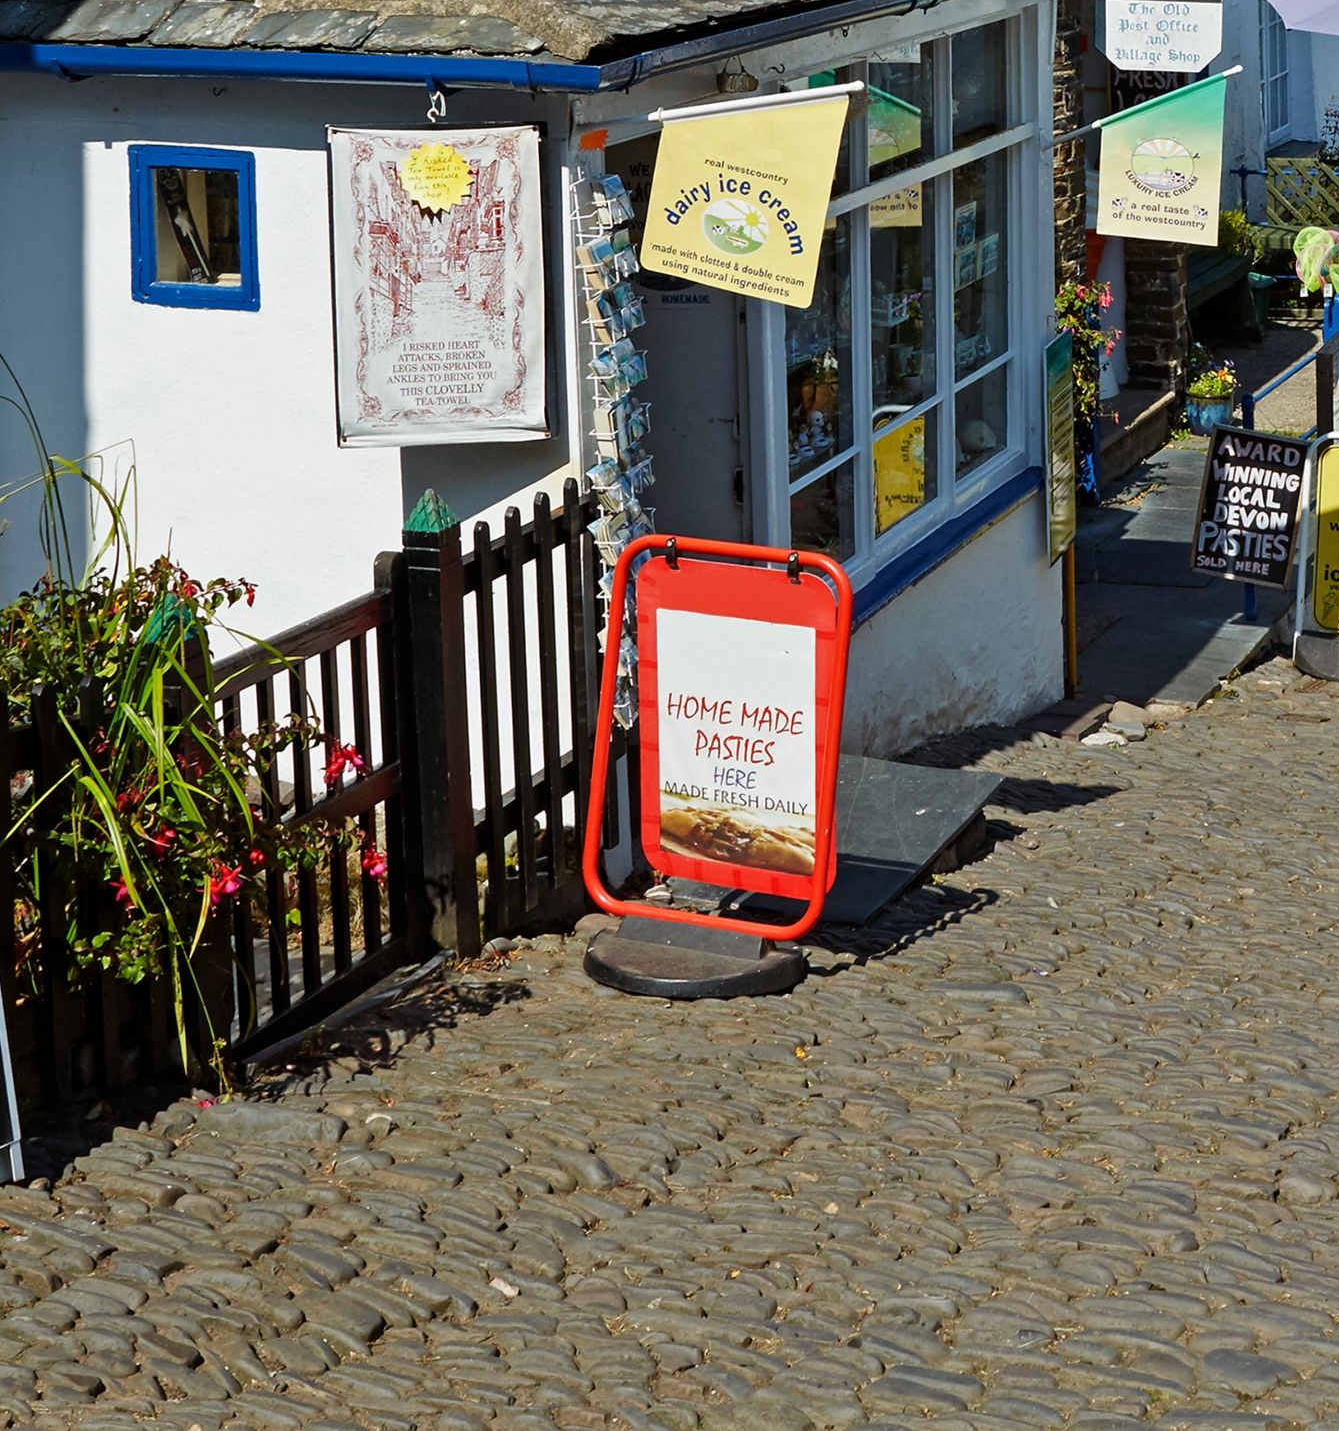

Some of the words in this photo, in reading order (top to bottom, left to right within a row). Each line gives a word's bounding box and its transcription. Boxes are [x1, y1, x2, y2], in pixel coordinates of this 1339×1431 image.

[1128, 3, 1155, 15] The
[1164, 3, 1190, 16] Old
[1118, 19, 1148, 33] Post
[1156, 19, 1199, 32] Office
[1146, 33, 1170, 46] and
[1115, 48, 1162, 65] Village
[1168, 49, 1200, 64] Shop
[704, 158, 725, 169] real
[727, 163, 789, 185] westcountry
[1125, 169, 1152, 196] LUXURY
[1155, 189, 1171, 199] ICE
[1174, 176, 1199, 197] CREAM
[664, 181, 711, 226] dairy
[718, 173, 751, 196] ice
[758, 189, 804, 255] cream
[1131, 201, 1137, 209] a
[1141, 202, 1161, 212] real
[1164, 203, 1190, 215] taste
[1112, 210, 1124, 220] of
[1126, 212, 1141, 222] the
[1144, 216, 1206, 231] westcountry
[652, 243, 678, 256] made
[679, 250, 698, 261] with
[700, 255, 731, 269] clotted
[733, 262, 740, 271] &
[742, 266, 773, 280] double
[775, 274, 805, 287] cream
[662, 259, 689, 275] using
[692, 266, 728, 282] natural
[730, 275, 790, 297] ingredients
[661, 294, 711, 304] HOMEMADE
[398, 353, 443, 363] ATTACKS,
[445, 351, 486, 361] BROKEN
[409, 342, 445, 352] RISKED
[448, 340, 480, 350] HEART
[387, 374, 425, 384] ANKLES
[428, 373, 441, 382] TO
[444, 372, 474, 382] BRING
[477, 371, 497, 380] YOU
[392, 364, 417, 373] LEGS
[420, 363, 440, 372] AND
[443, 361, 491, 371] SPRAINED
[400, 387, 423, 396] THIS
[426, 383, 484, 395] CLOVELLY
[1217, 434, 1300, 467] AWARD
[1212, 458, 1300, 493] WINNING
[1217, 483, 1281, 509] LOCAL
[1213, 501, 1288, 531] DEVON
[1198, 520, 1290, 562] PASTIES
[1196, 554, 1228, 568] SOLD
[1235, 560, 1270, 576] HERE
[667, 693, 733, 724] HOME
[741, 703, 803, 735] MADE
[695, 730, 775, 766] PASTIES
[714, 766, 757, 790] HERE
[664, 781, 708, 801] MADE
[714, 789, 759, 809] FRESH
[765, 796, 808, 816] DAILY
